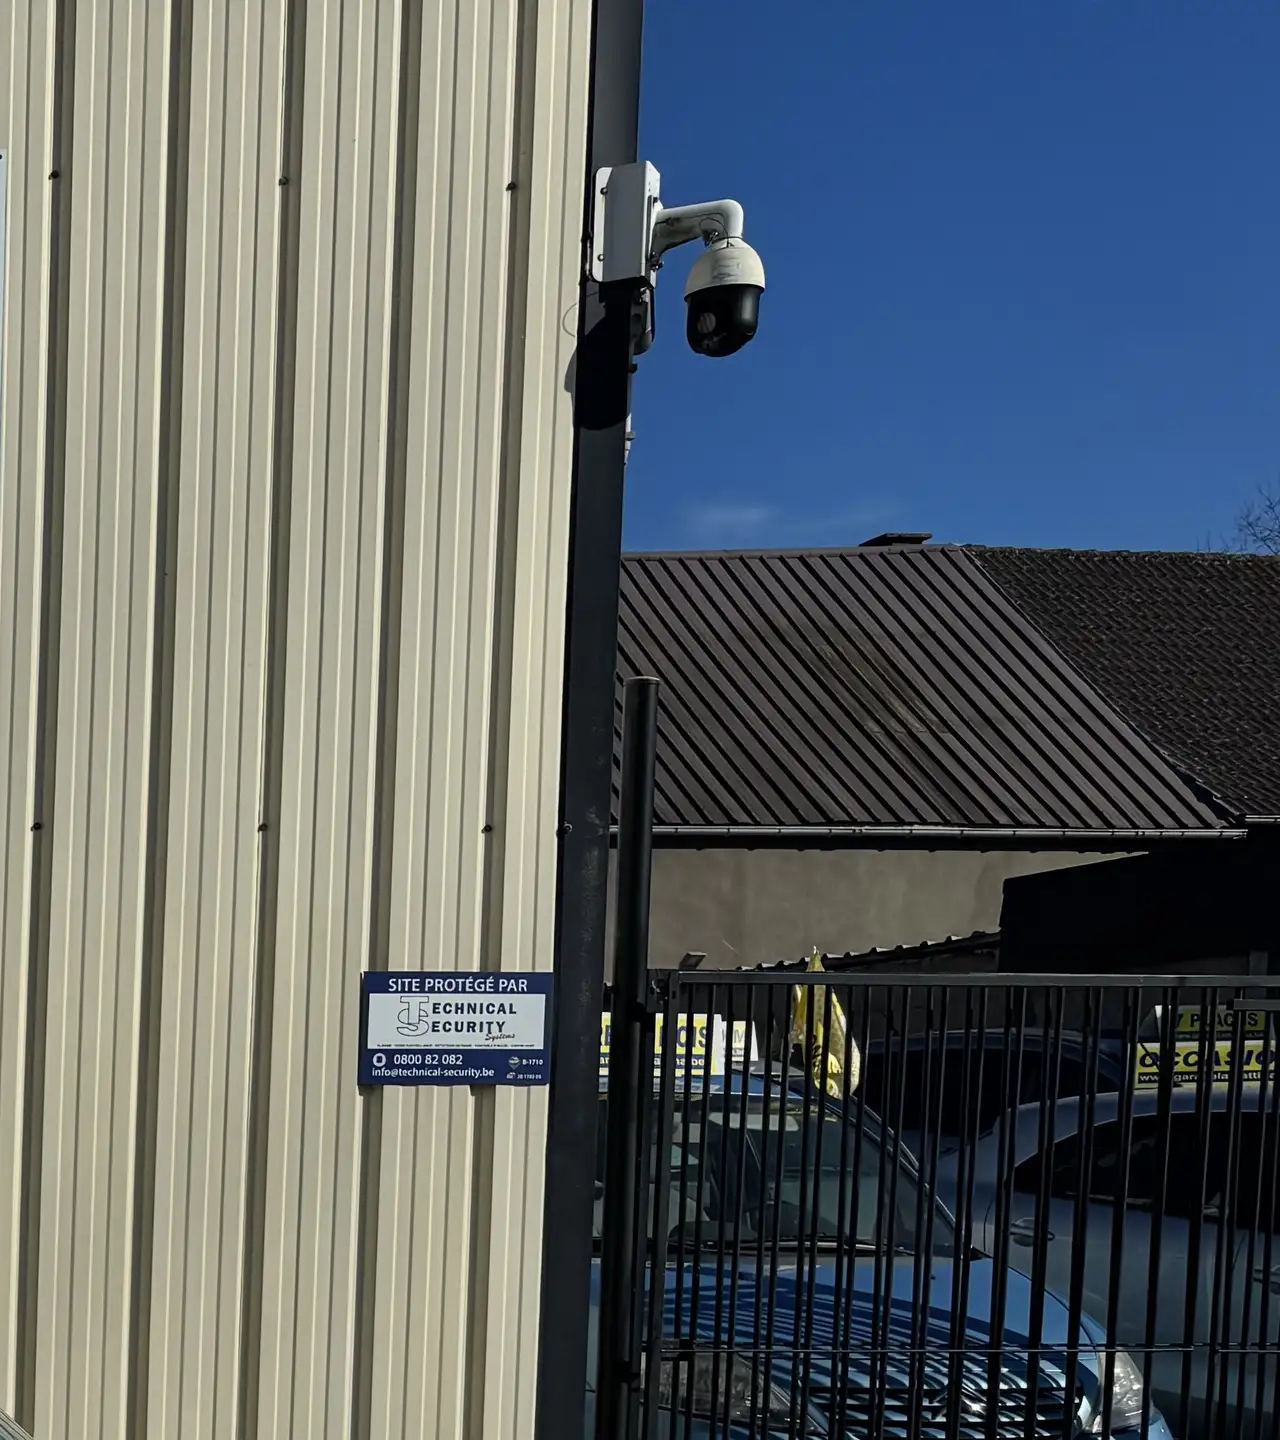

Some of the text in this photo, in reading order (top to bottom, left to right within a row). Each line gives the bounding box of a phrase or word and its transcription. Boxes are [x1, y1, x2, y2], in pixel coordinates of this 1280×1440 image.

[388, 975, 528, 992] SITE PROTÉGÉ PAR
[393, 1054, 463, 1065] 0800 82 082
[372, 1067, 495, 1079] info@technical-security.be
